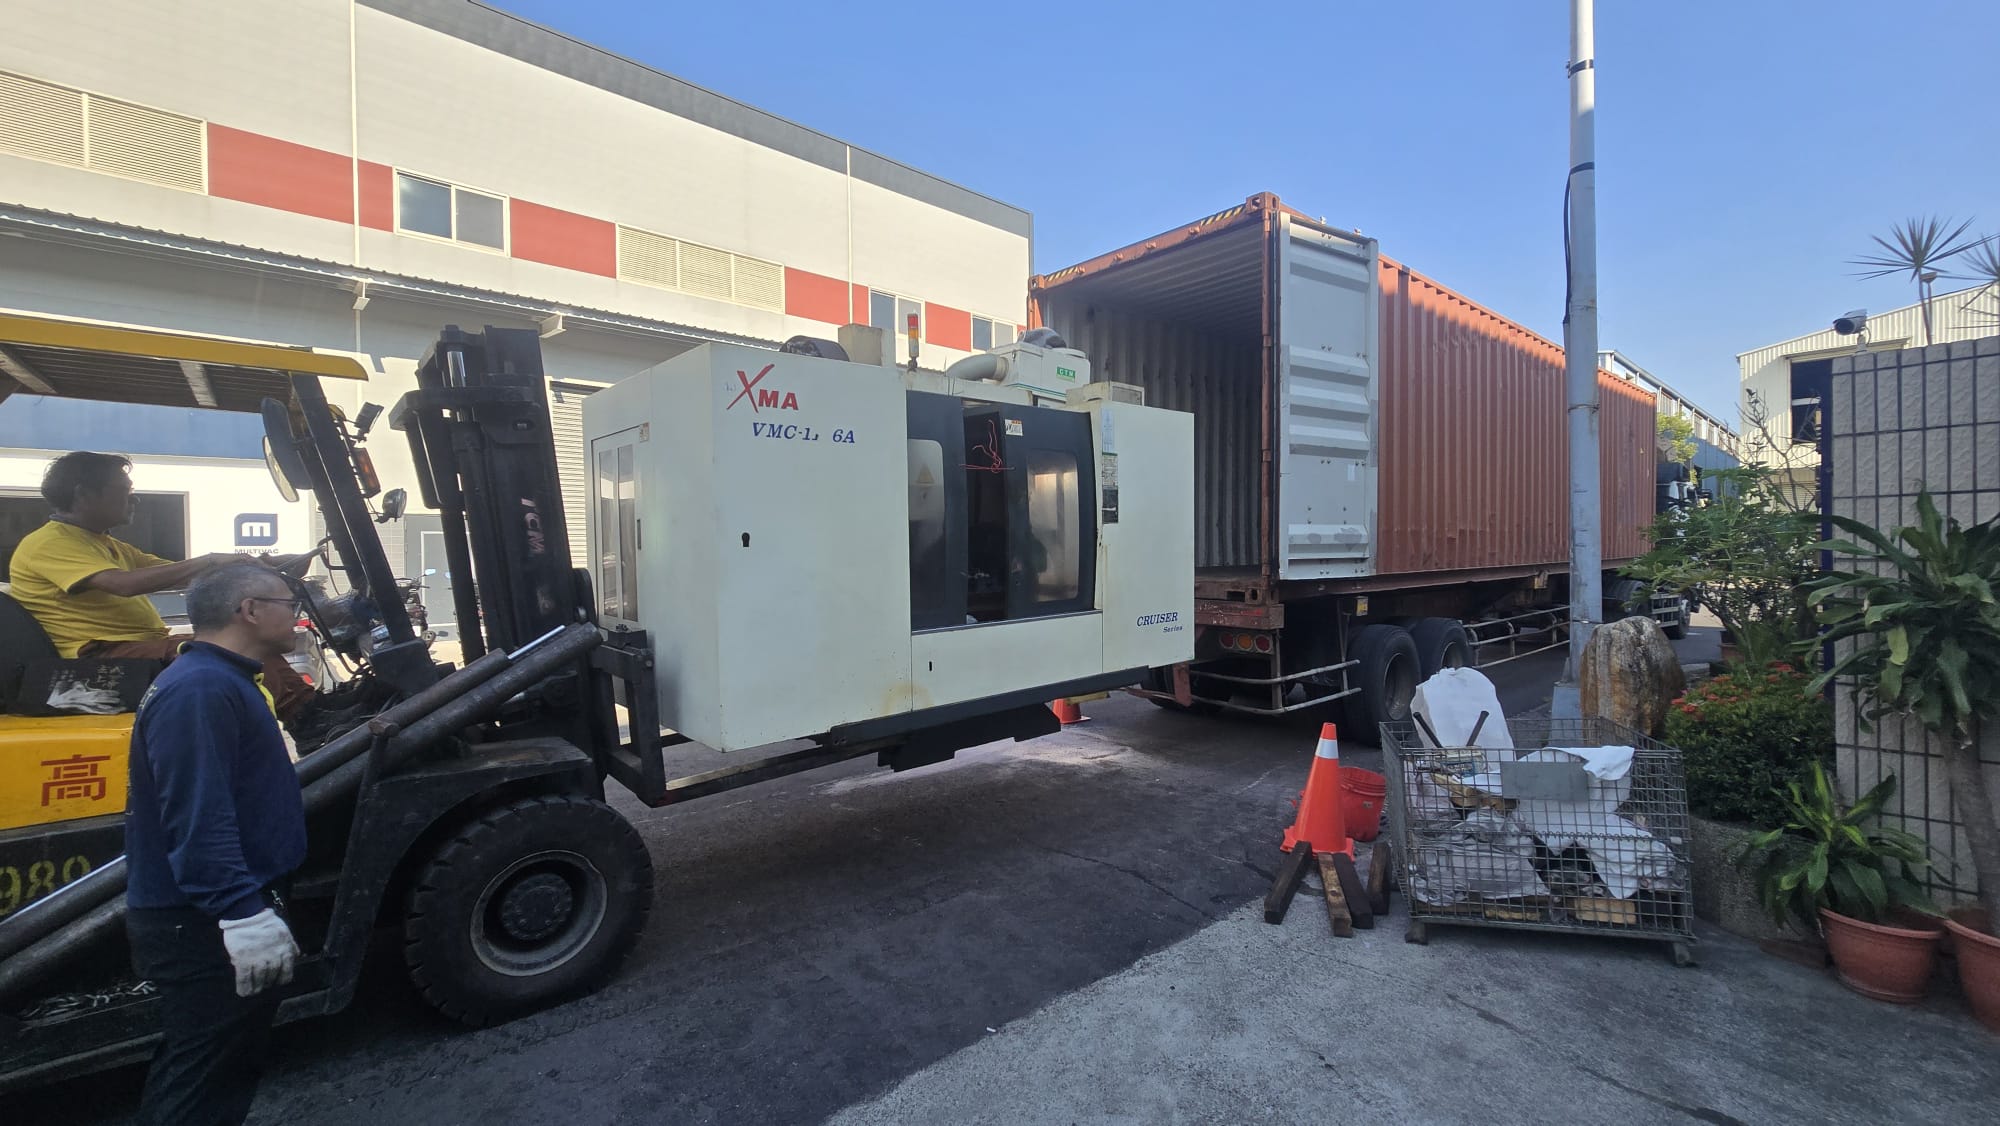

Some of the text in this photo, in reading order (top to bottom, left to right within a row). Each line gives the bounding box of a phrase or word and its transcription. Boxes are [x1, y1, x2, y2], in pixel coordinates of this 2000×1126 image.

[726, 363, 799, 413] XMA
[1136, 611, 1178, 627] CRUISER
[1163, 625, 1183, 633] Series
[40, 754, 111, 807] 高
